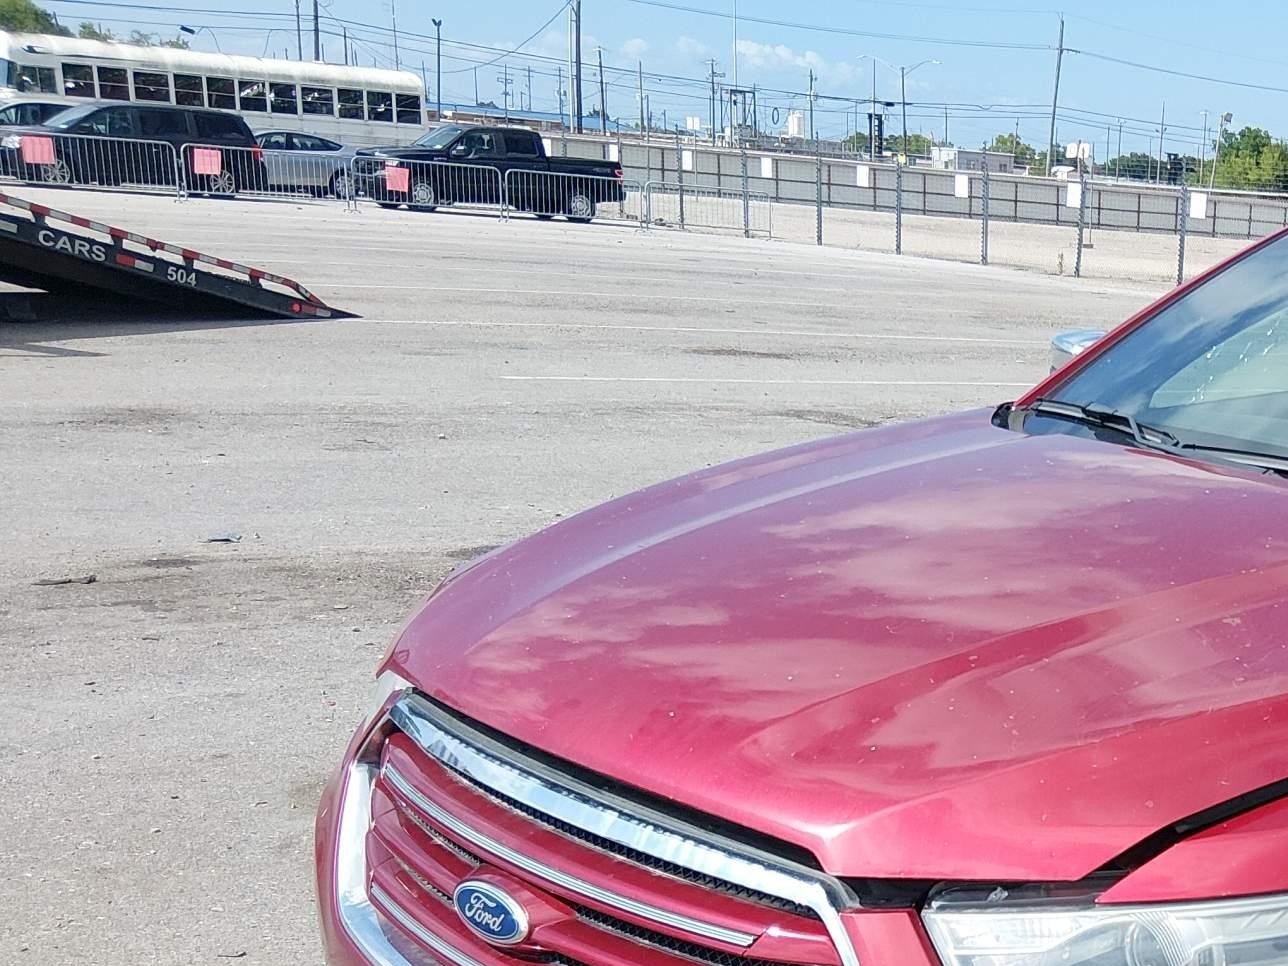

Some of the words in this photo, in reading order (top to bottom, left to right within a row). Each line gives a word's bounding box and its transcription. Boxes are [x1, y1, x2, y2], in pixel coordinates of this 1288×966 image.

[38, 230, 106, 262] CARS
[167, 266, 197, 287] 504
[465, 892, 505, 932] Ford
